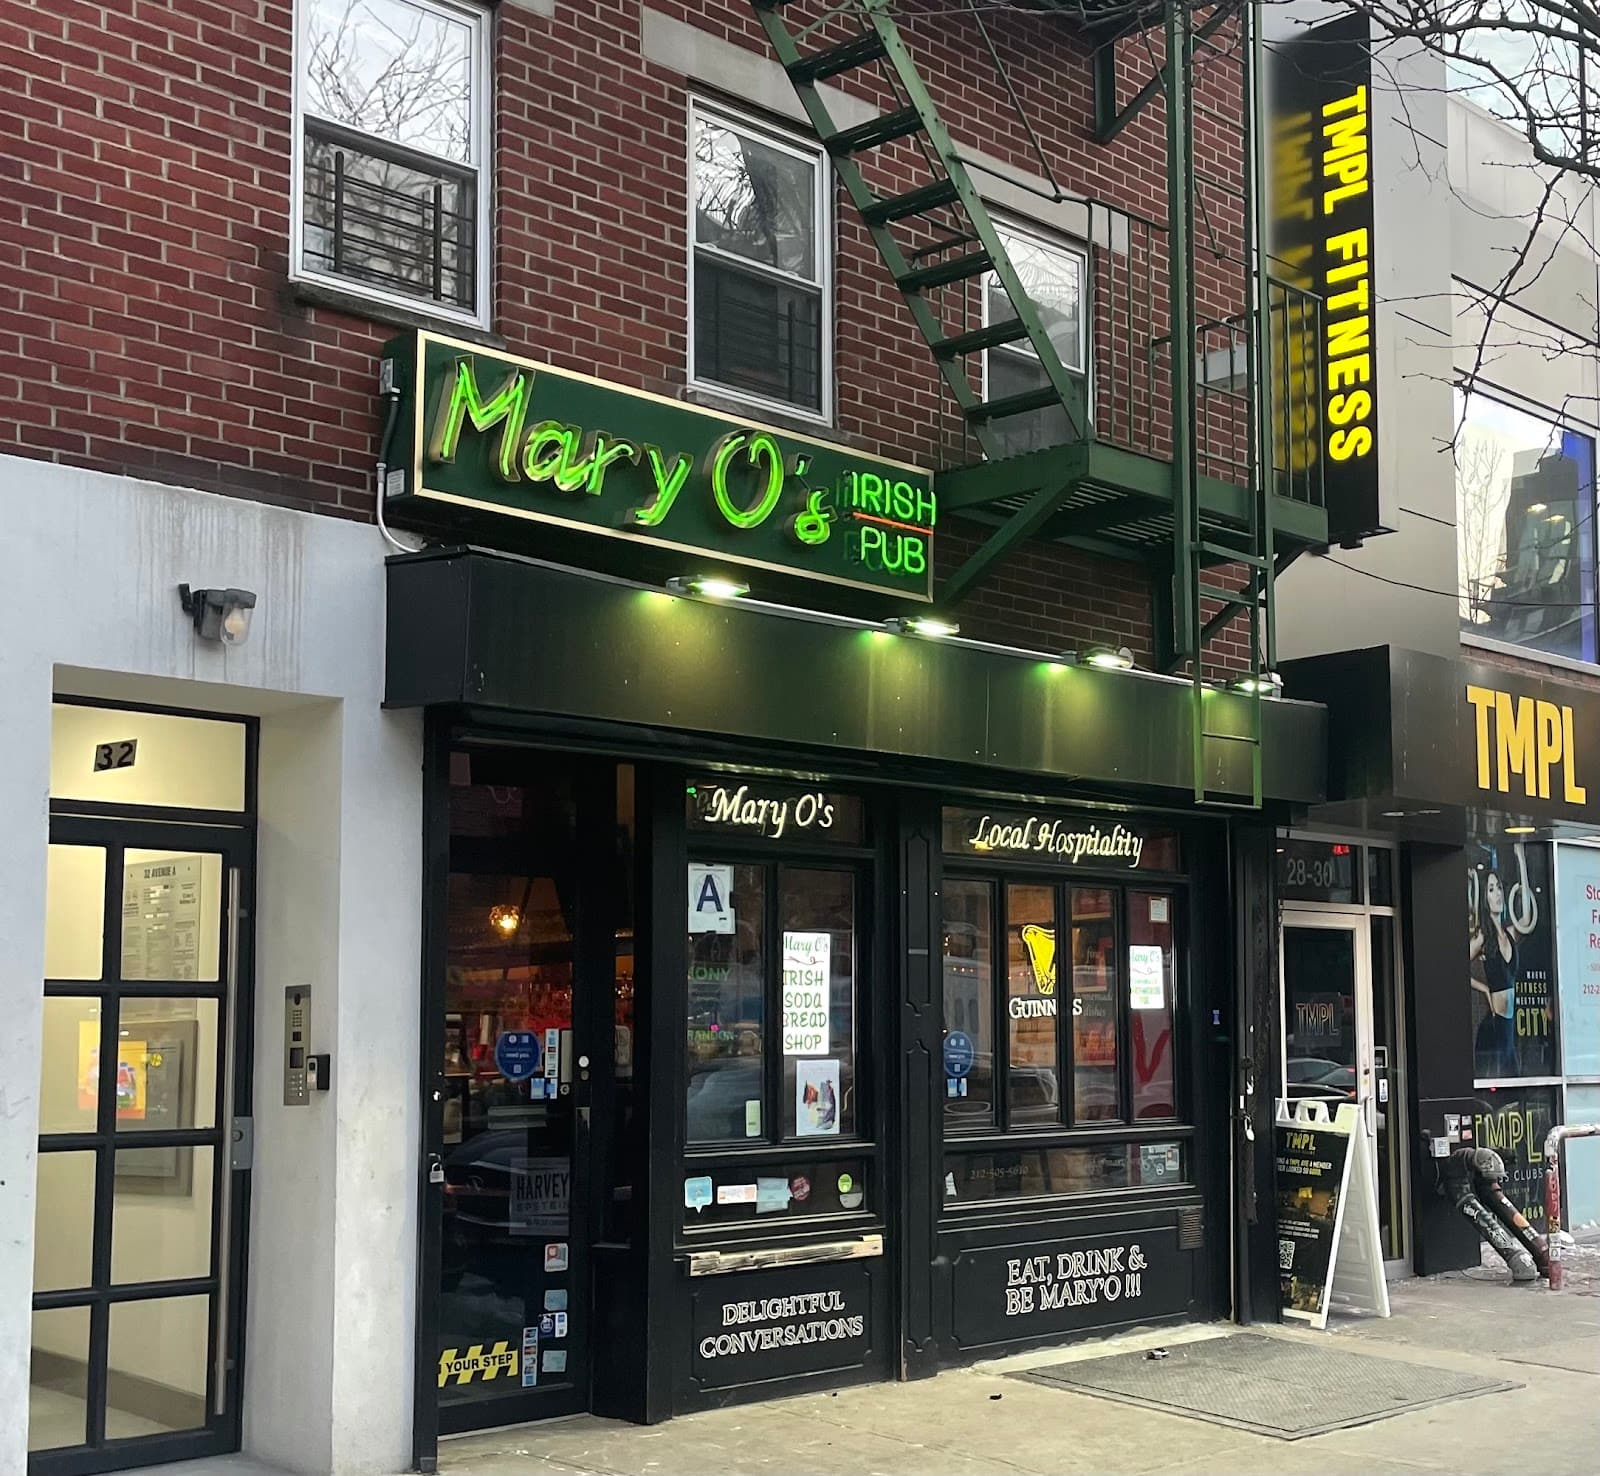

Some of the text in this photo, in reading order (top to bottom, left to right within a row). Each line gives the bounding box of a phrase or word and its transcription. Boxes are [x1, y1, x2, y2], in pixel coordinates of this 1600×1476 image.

[1322, 85, 1372, 462] TMPL FITNESS
[430, 355, 835, 546] Mary O's
[850, 471, 937, 527] IRISH
[860, 525, 925, 575] PUB
[96, 744, 131, 770] 32
[1466, 684, 1586, 805] TMPL
[704, 786, 834, 839] Mary O's
[969, 816, 1143, 868] Local Hospitality
[1286, 858, 1333, 888] 28-30
[696, 874, 724, 912] A
[783, 969, 825, 987] IRISH
[1515, 981, 1548, 994] FITNESS
[784, 991, 823, 1009] SODA
[1008, 997, 1083, 1019] GUINNS
[1515, 996, 1536, 1006] MEETS
[783, 1011, 828, 1028] BREAD
[1295, 1002, 1340, 1037] TMPL
[1516, 1007, 1548, 1037] CITY
[784, 1033, 823, 1050] SHOP
[1286, 1131, 1317, 1151] TMPL
[1475, 1110, 1543, 1164] TMPL
[516, 1173, 569, 1200] HARVEY
[1513, 1167, 1543, 1181] CLUBS
[1007, 1244, 1148, 1286] EAT, DRINK &
[722, 1290, 846, 1326] DELIGHTFUL
[1005, 1288, 1035, 1316] BE
[700, 1315, 865, 1360] CONVERSATIONS
[446, 1358, 480, 1373] YOUR
[483, 1353, 513, 1367] STEP
